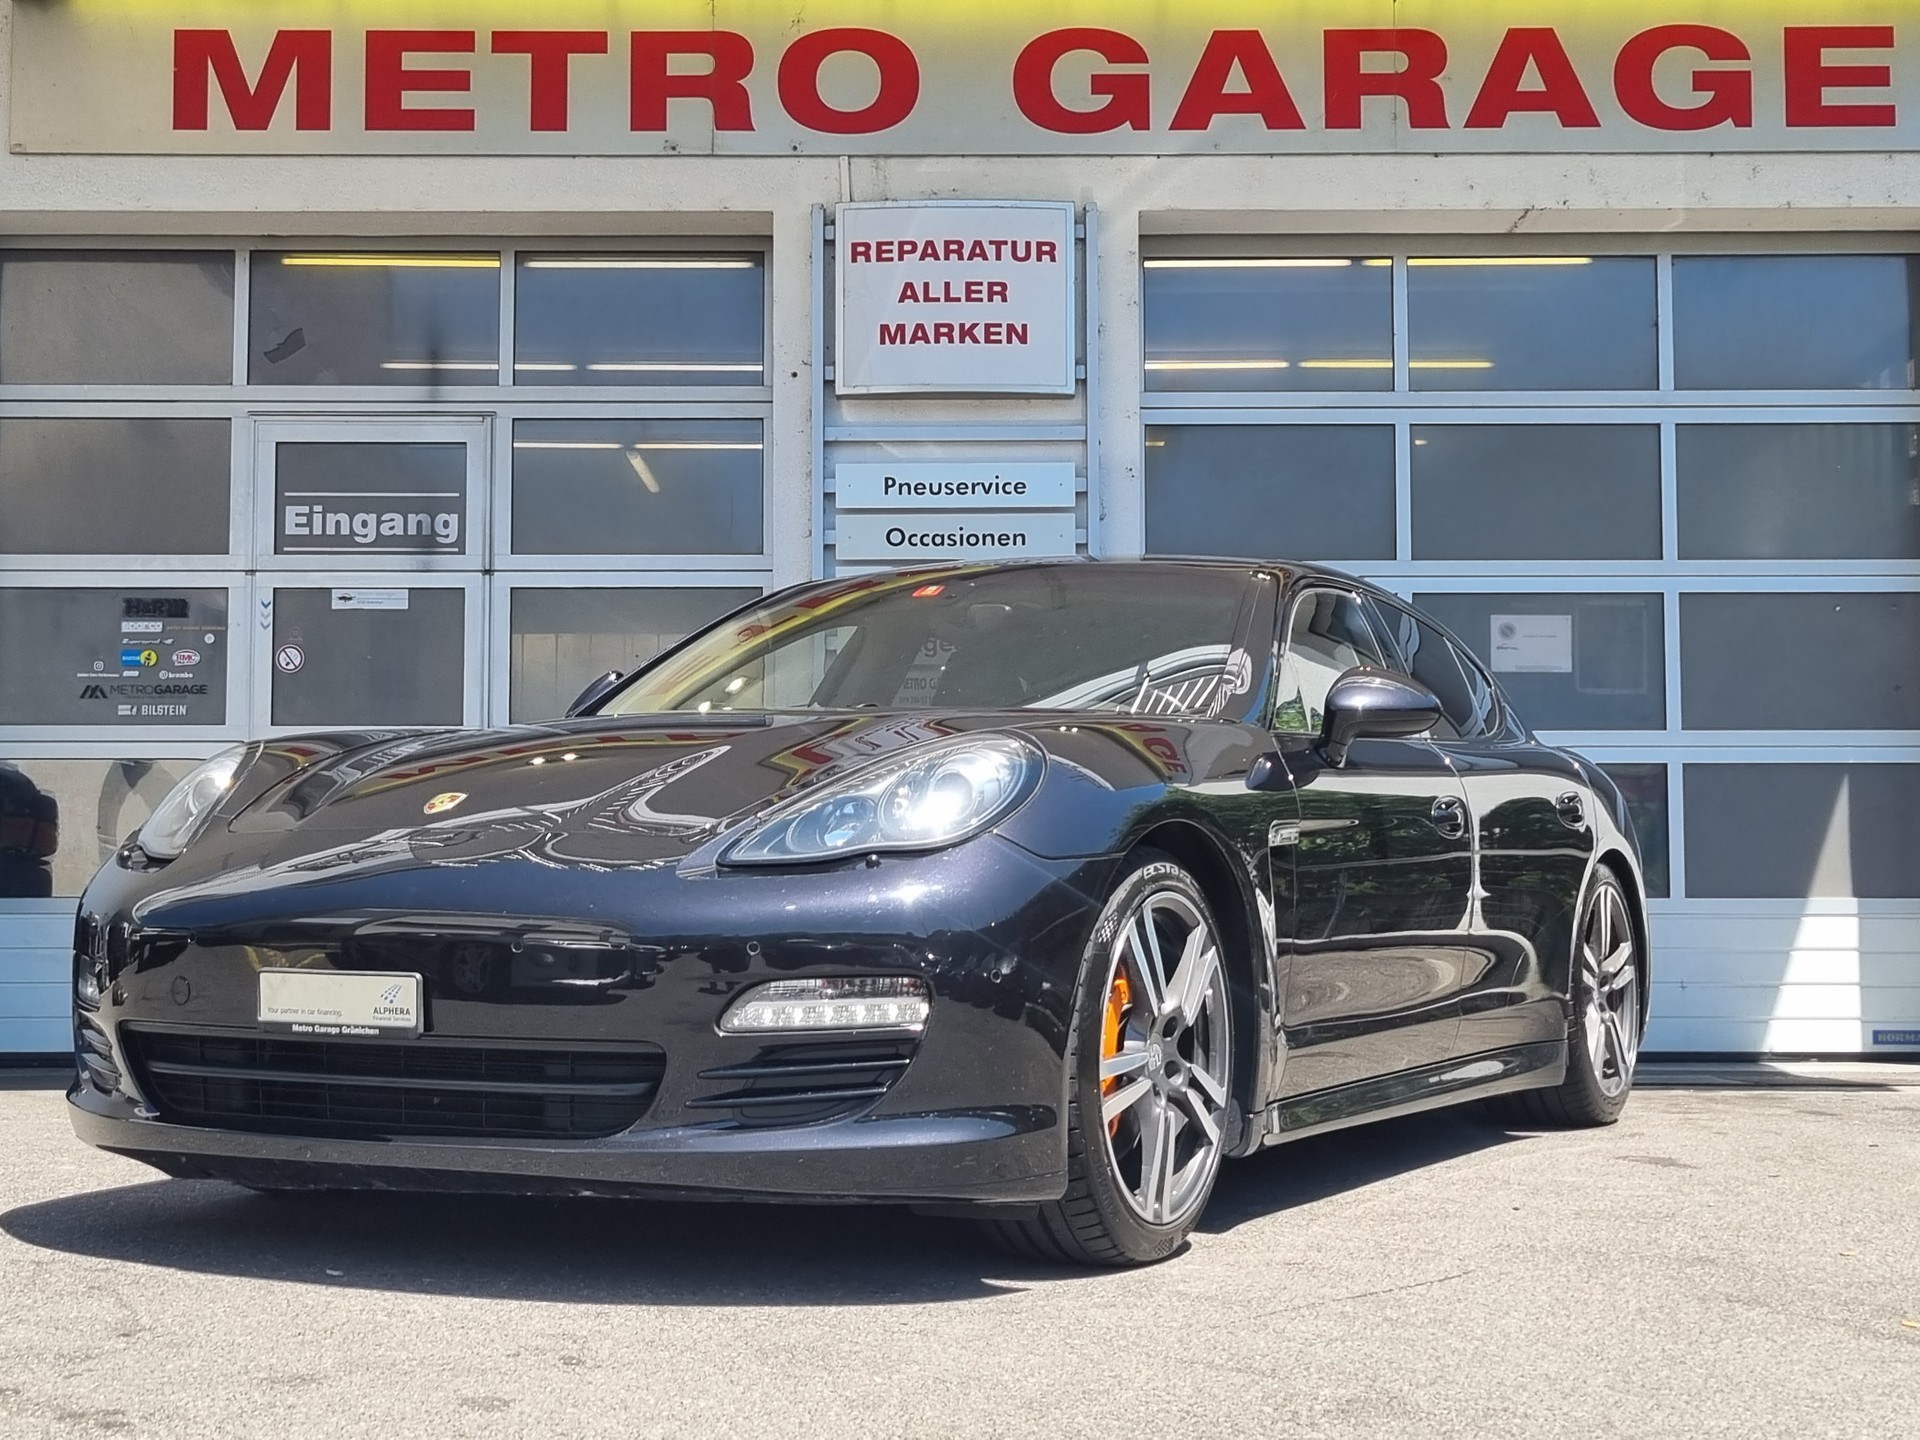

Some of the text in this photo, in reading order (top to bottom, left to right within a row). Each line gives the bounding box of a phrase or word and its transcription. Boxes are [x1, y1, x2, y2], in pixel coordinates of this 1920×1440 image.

[172, 24, 1896, 134] METRO GARAGE
[850, 240, 1057, 263] REPARATUR
[897, 281, 1009, 304] ALLER
[879, 322, 1028, 346] MARKEN
[883, 474, 1028, 496] Pneuservice
[284, 504, 460, 544] Eingang
[884, 526, 1027, 548] Occasionen
[141, 704, 187, 716] BILSTEIN
[316, 1009, 343, 1017] financing.
[372, 1006, 411, 1016] ALPHERA
[292, 1023, 313, 1032] Metro
[314, 1024, 340, 1035] Garage
